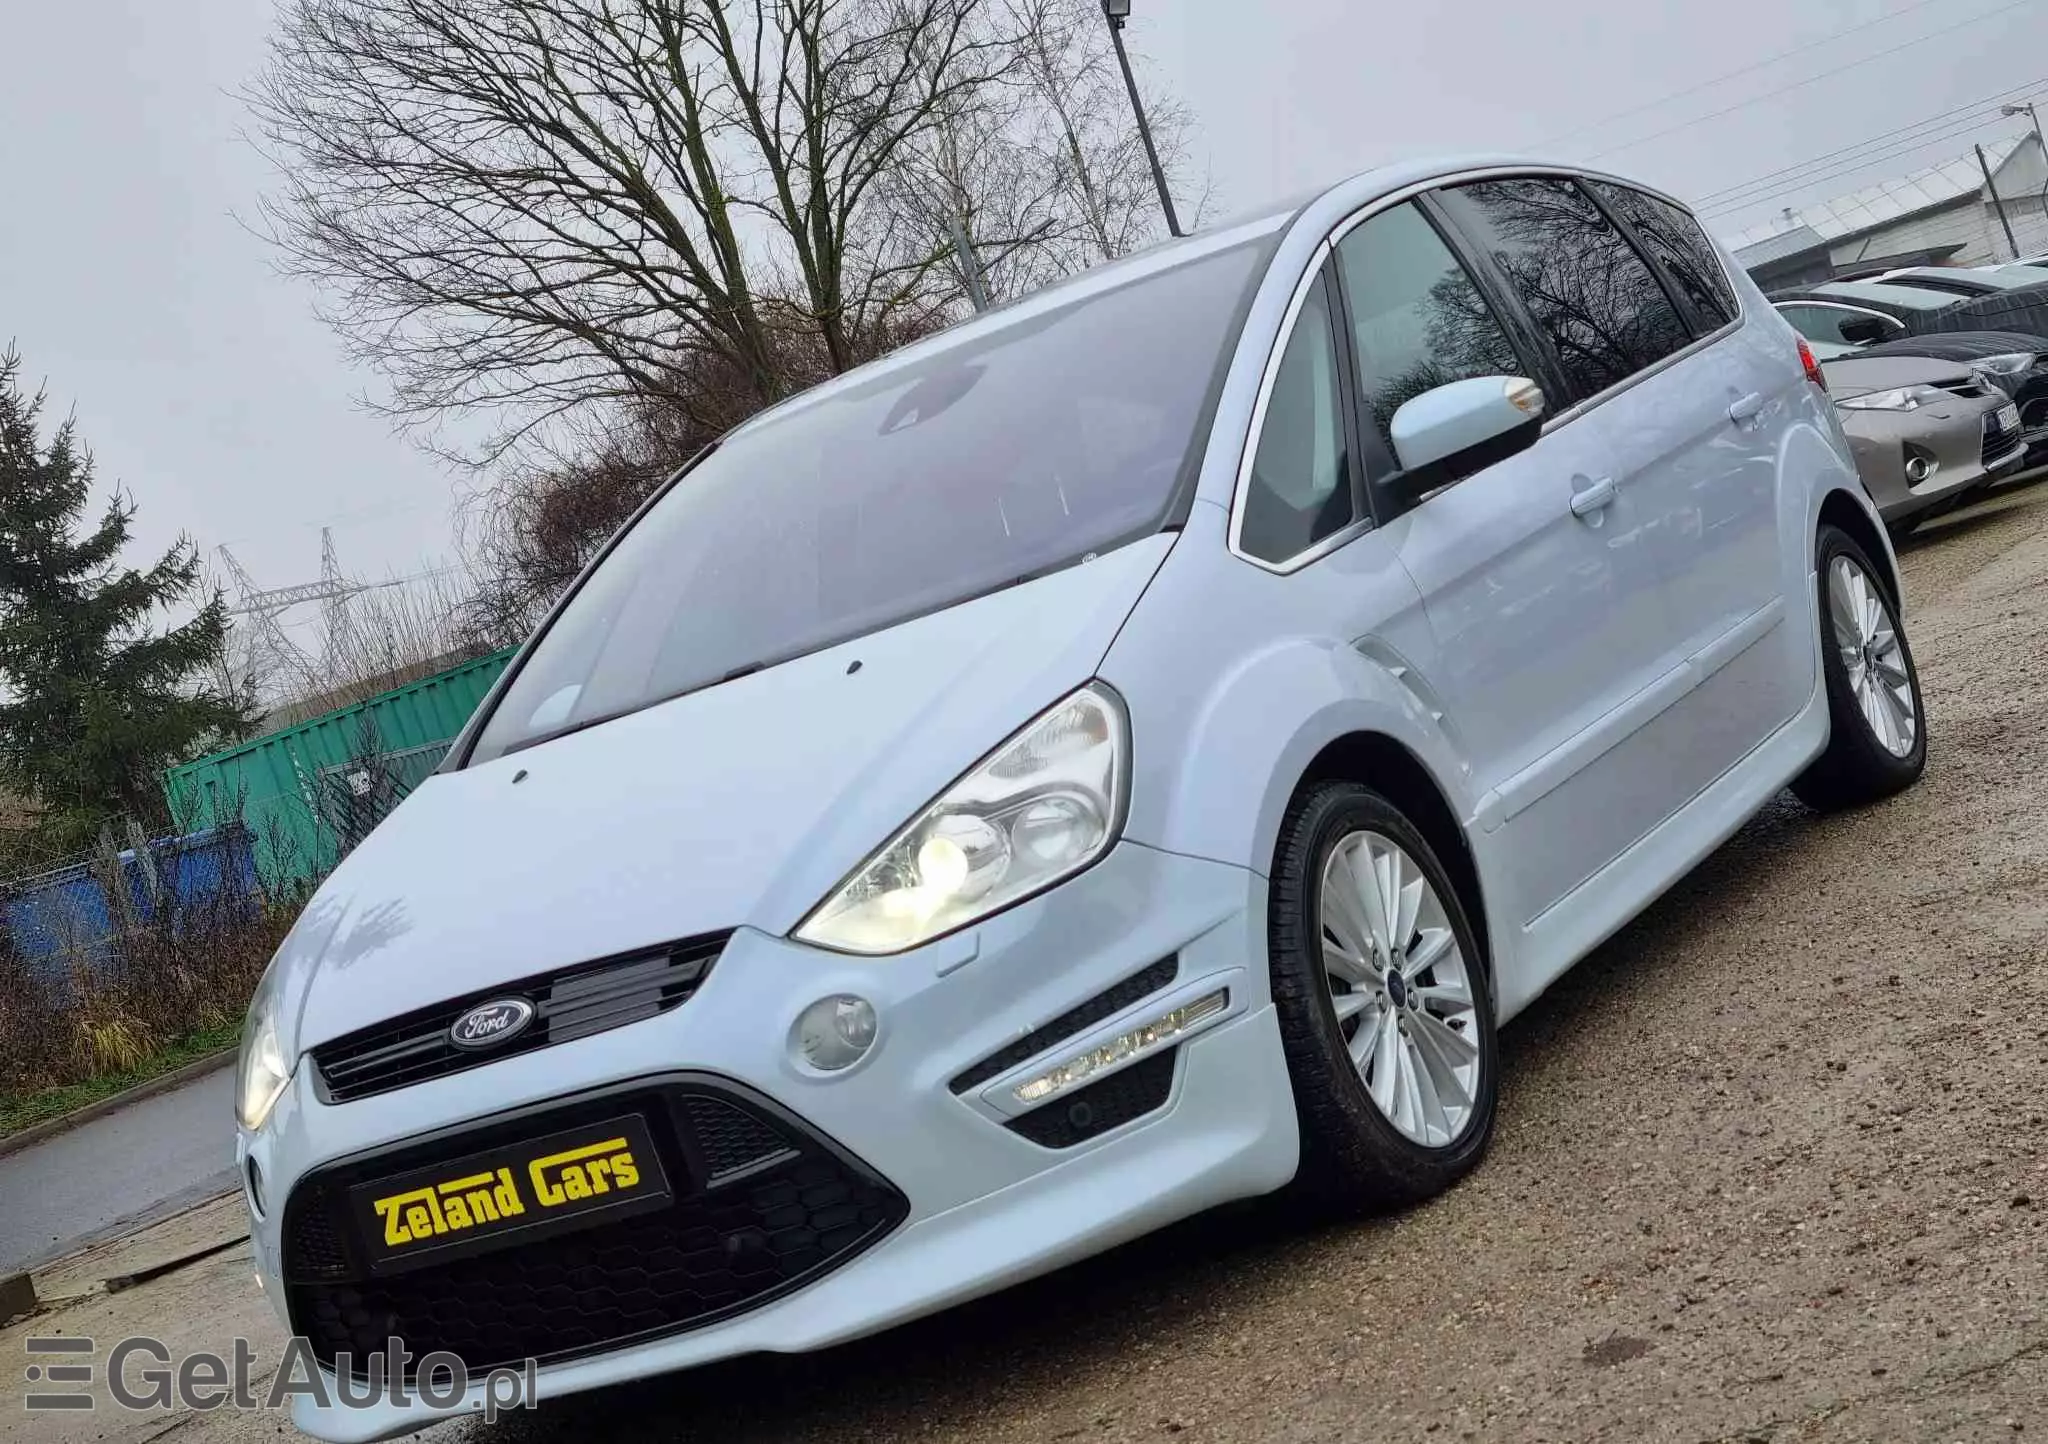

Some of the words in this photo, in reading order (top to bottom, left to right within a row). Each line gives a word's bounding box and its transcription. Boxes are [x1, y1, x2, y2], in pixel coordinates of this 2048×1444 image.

[464, 1008, 510, 1038] Ford
[374, 1167, 525, 1246] Zeland
[528, 1137, 640, 1207] Cars
